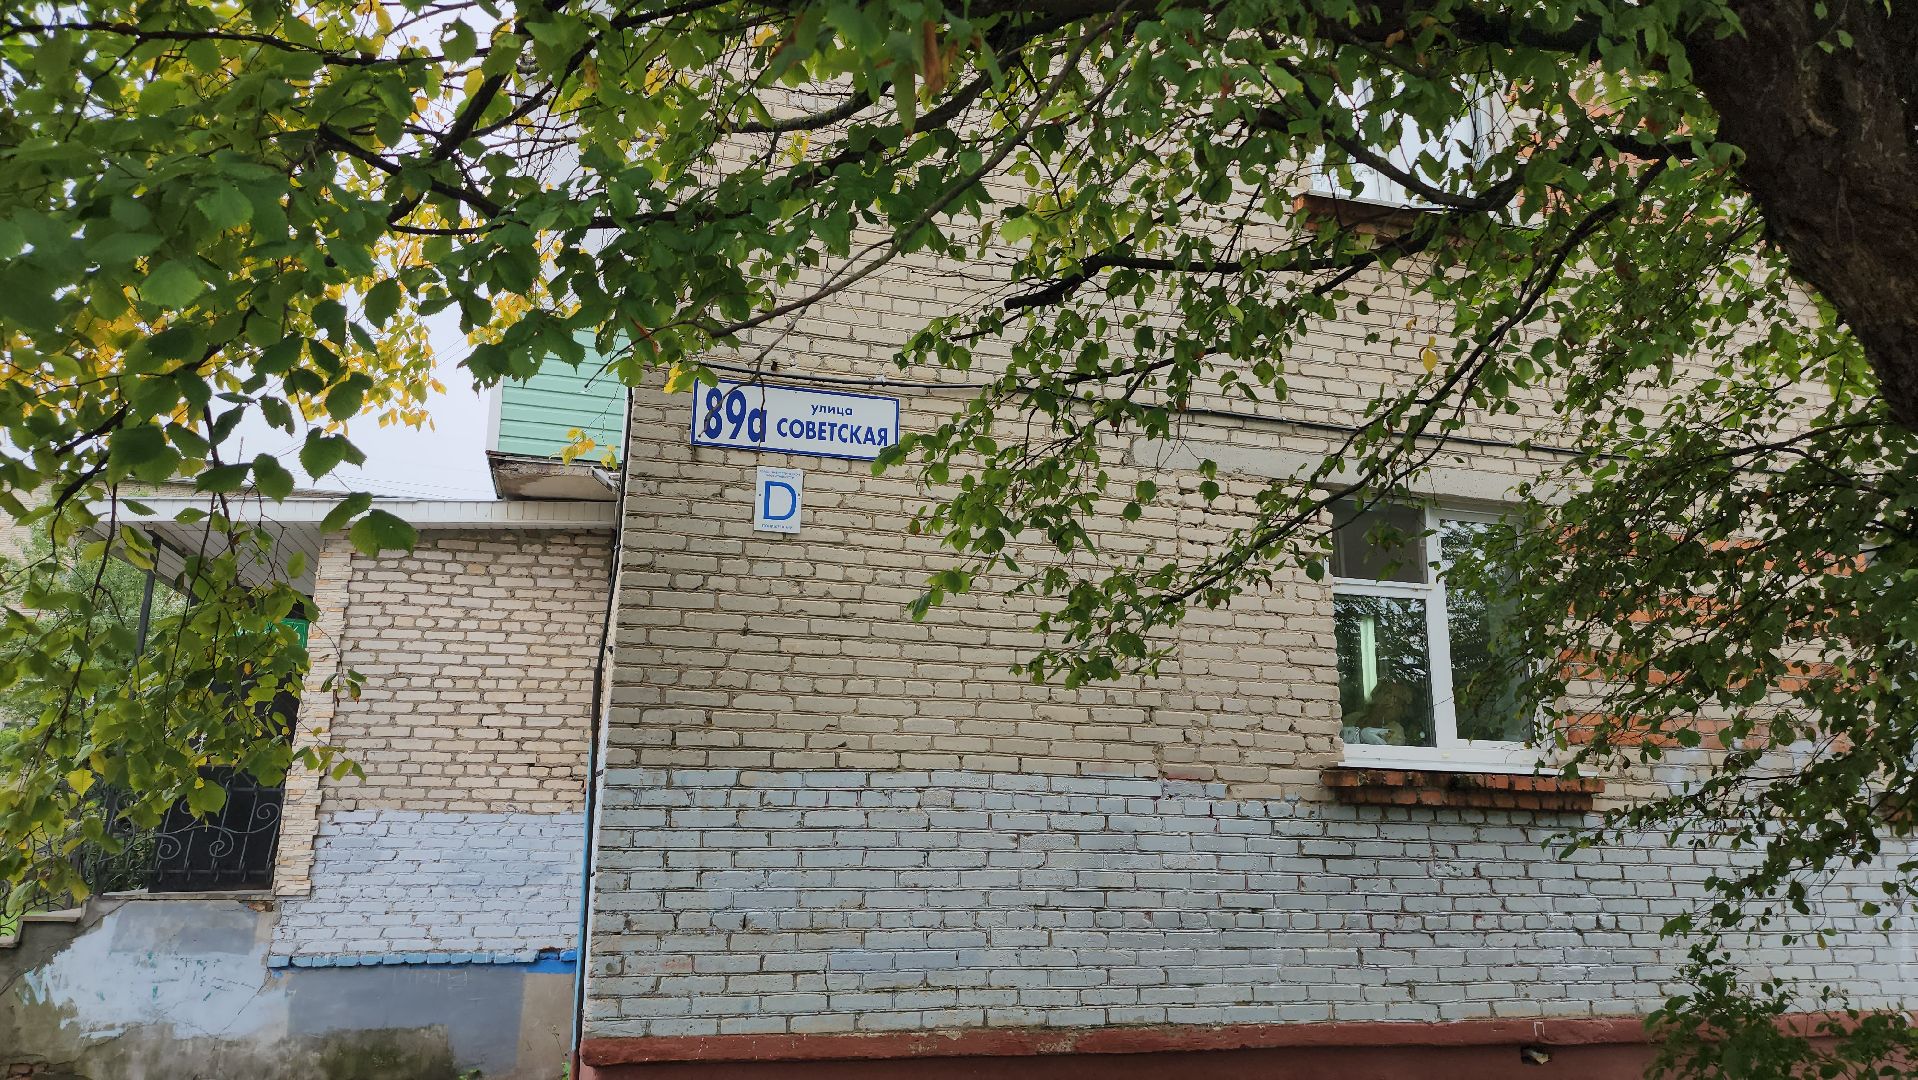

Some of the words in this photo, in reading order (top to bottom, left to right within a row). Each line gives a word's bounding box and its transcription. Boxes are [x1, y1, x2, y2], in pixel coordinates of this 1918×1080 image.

[811, 404, 853, 416] улица
[776, 418, 888, 446] СОВЕТСКАЯ
[764, 480, 796, 520] D
